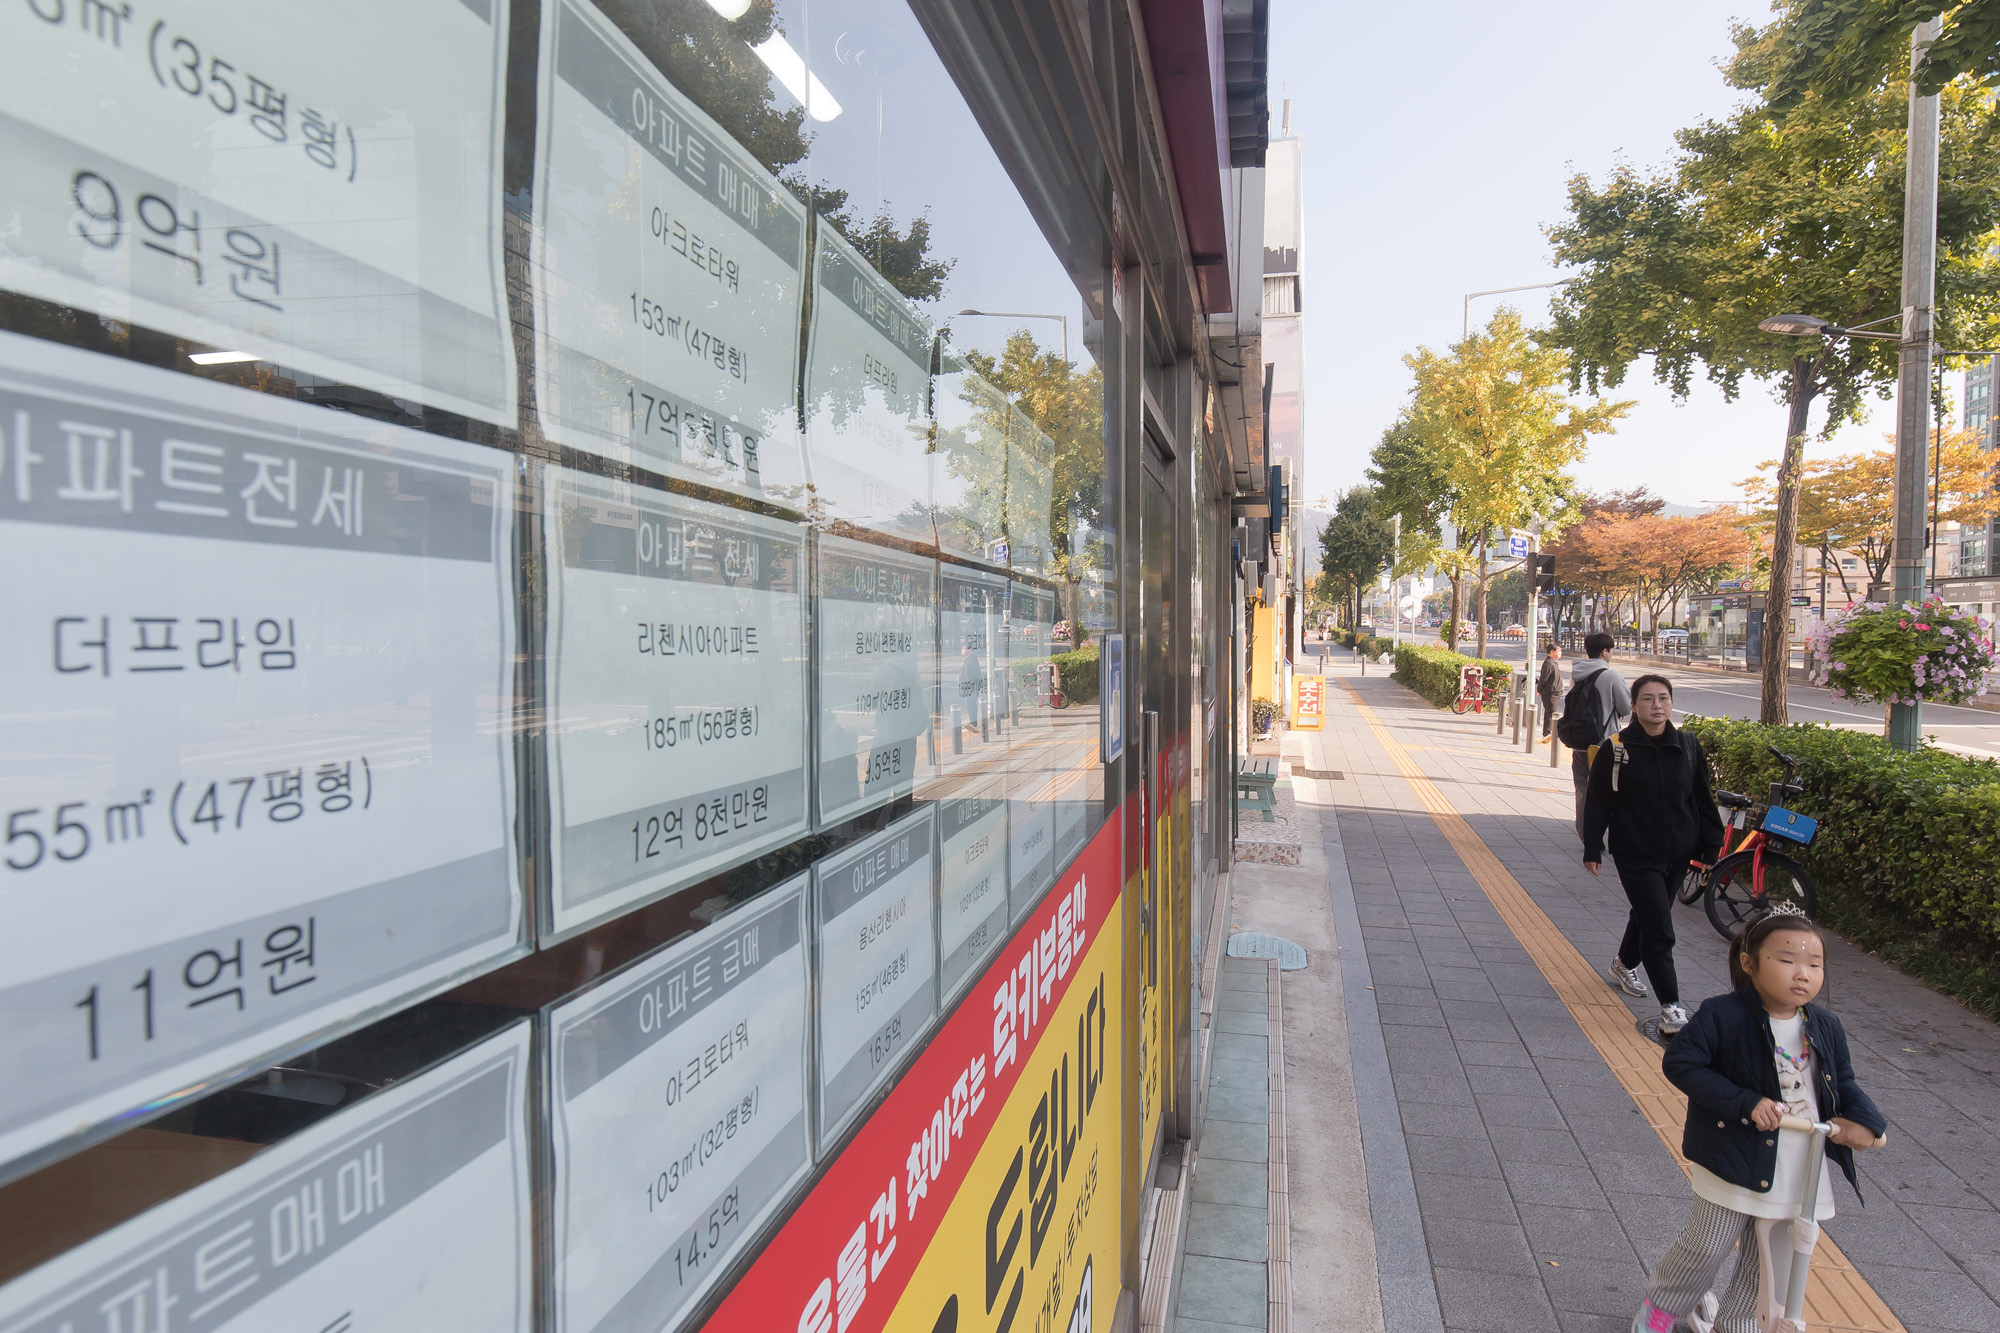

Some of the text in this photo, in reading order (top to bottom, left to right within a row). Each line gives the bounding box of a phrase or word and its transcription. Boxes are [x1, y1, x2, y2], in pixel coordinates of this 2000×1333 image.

[631, 87, 760, 231] 아파트 매매
[72, 169, 284, 312] 9억원
[650, 205, 740, 296] 아크로타워
[852, 276, 887, 330] 아파트
[863, 353, 898, 395] 더프라임
[52, 615, 298, 678] 더프라임
[637, 622, 760, 657] 리첸시아아파트
[643, 704, 760, 751] 185㎡(56평형)
[1299, 681, 1318, 714] 옷수선
[864, 746, 901, 785] 9.5억원
[852, 834, 910, 894] 아파트 매매
[1770, 823, 1788, 833] SOCAR
[74, 916, 318, 1060] 11억원
[638, 925, 761, 1035] 아파트 급매
[666, 1018, 751, 1107] 아크로타워
[868, 1014, 902, 1069] 16.5억
[906, 1052, 986, 1221] 찾아주는
[992, 872, 1087, 1079] 럭키부동산
[986, 970, 1105, 1333] 드립니다
[58, 1142, 386, 1333] 파트매매
[674, 1184, 740, 1288] 14.5억
